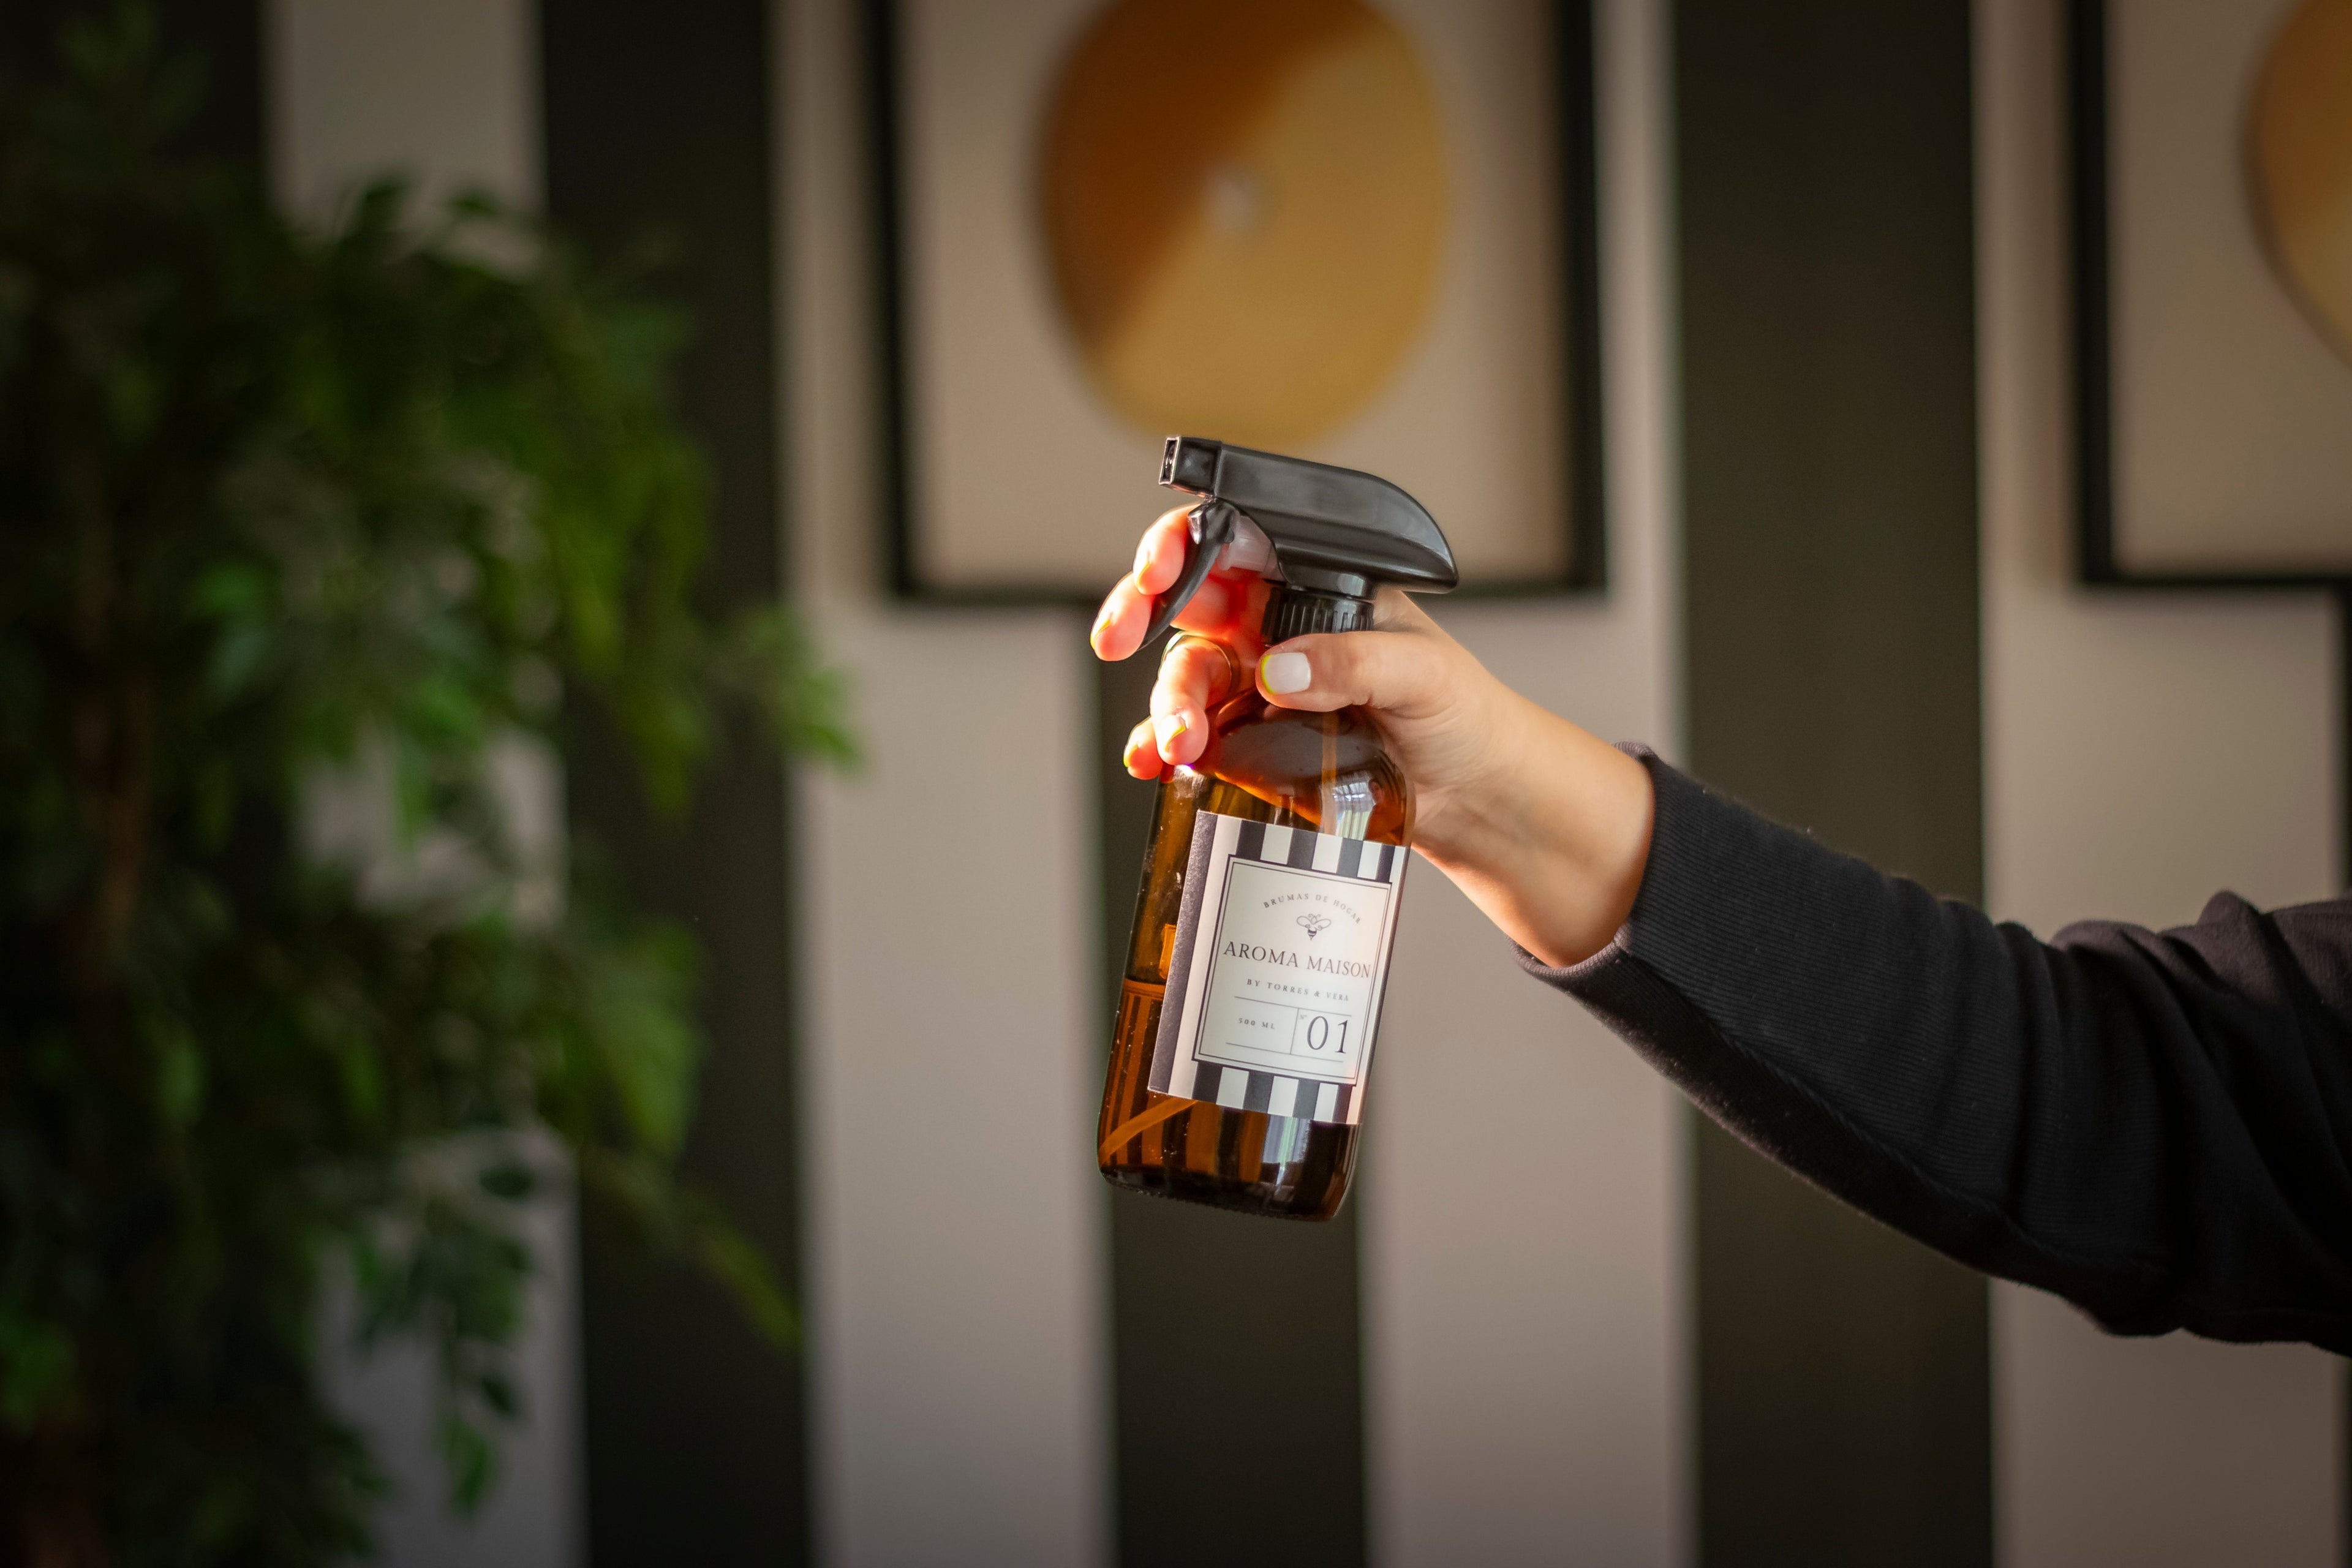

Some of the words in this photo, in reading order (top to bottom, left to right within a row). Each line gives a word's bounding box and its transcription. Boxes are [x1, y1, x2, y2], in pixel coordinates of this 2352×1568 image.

[1263, 893, 1309, 908] BRUMAS
[1333, 899, 1361, 924] HOGAR
[1223, 941, 1299, 968] AROMA
[1306, 956, 1371, 978] MAISON
[1267, 982, 1309, 995] TORRES
[1326, 992, 1349, 1001] VERA
[1238, 1017, 1256, 1026] 500
[1261, 1021, 1275, 1030] ML
[1307, 1016, 1348, 1054] 01
